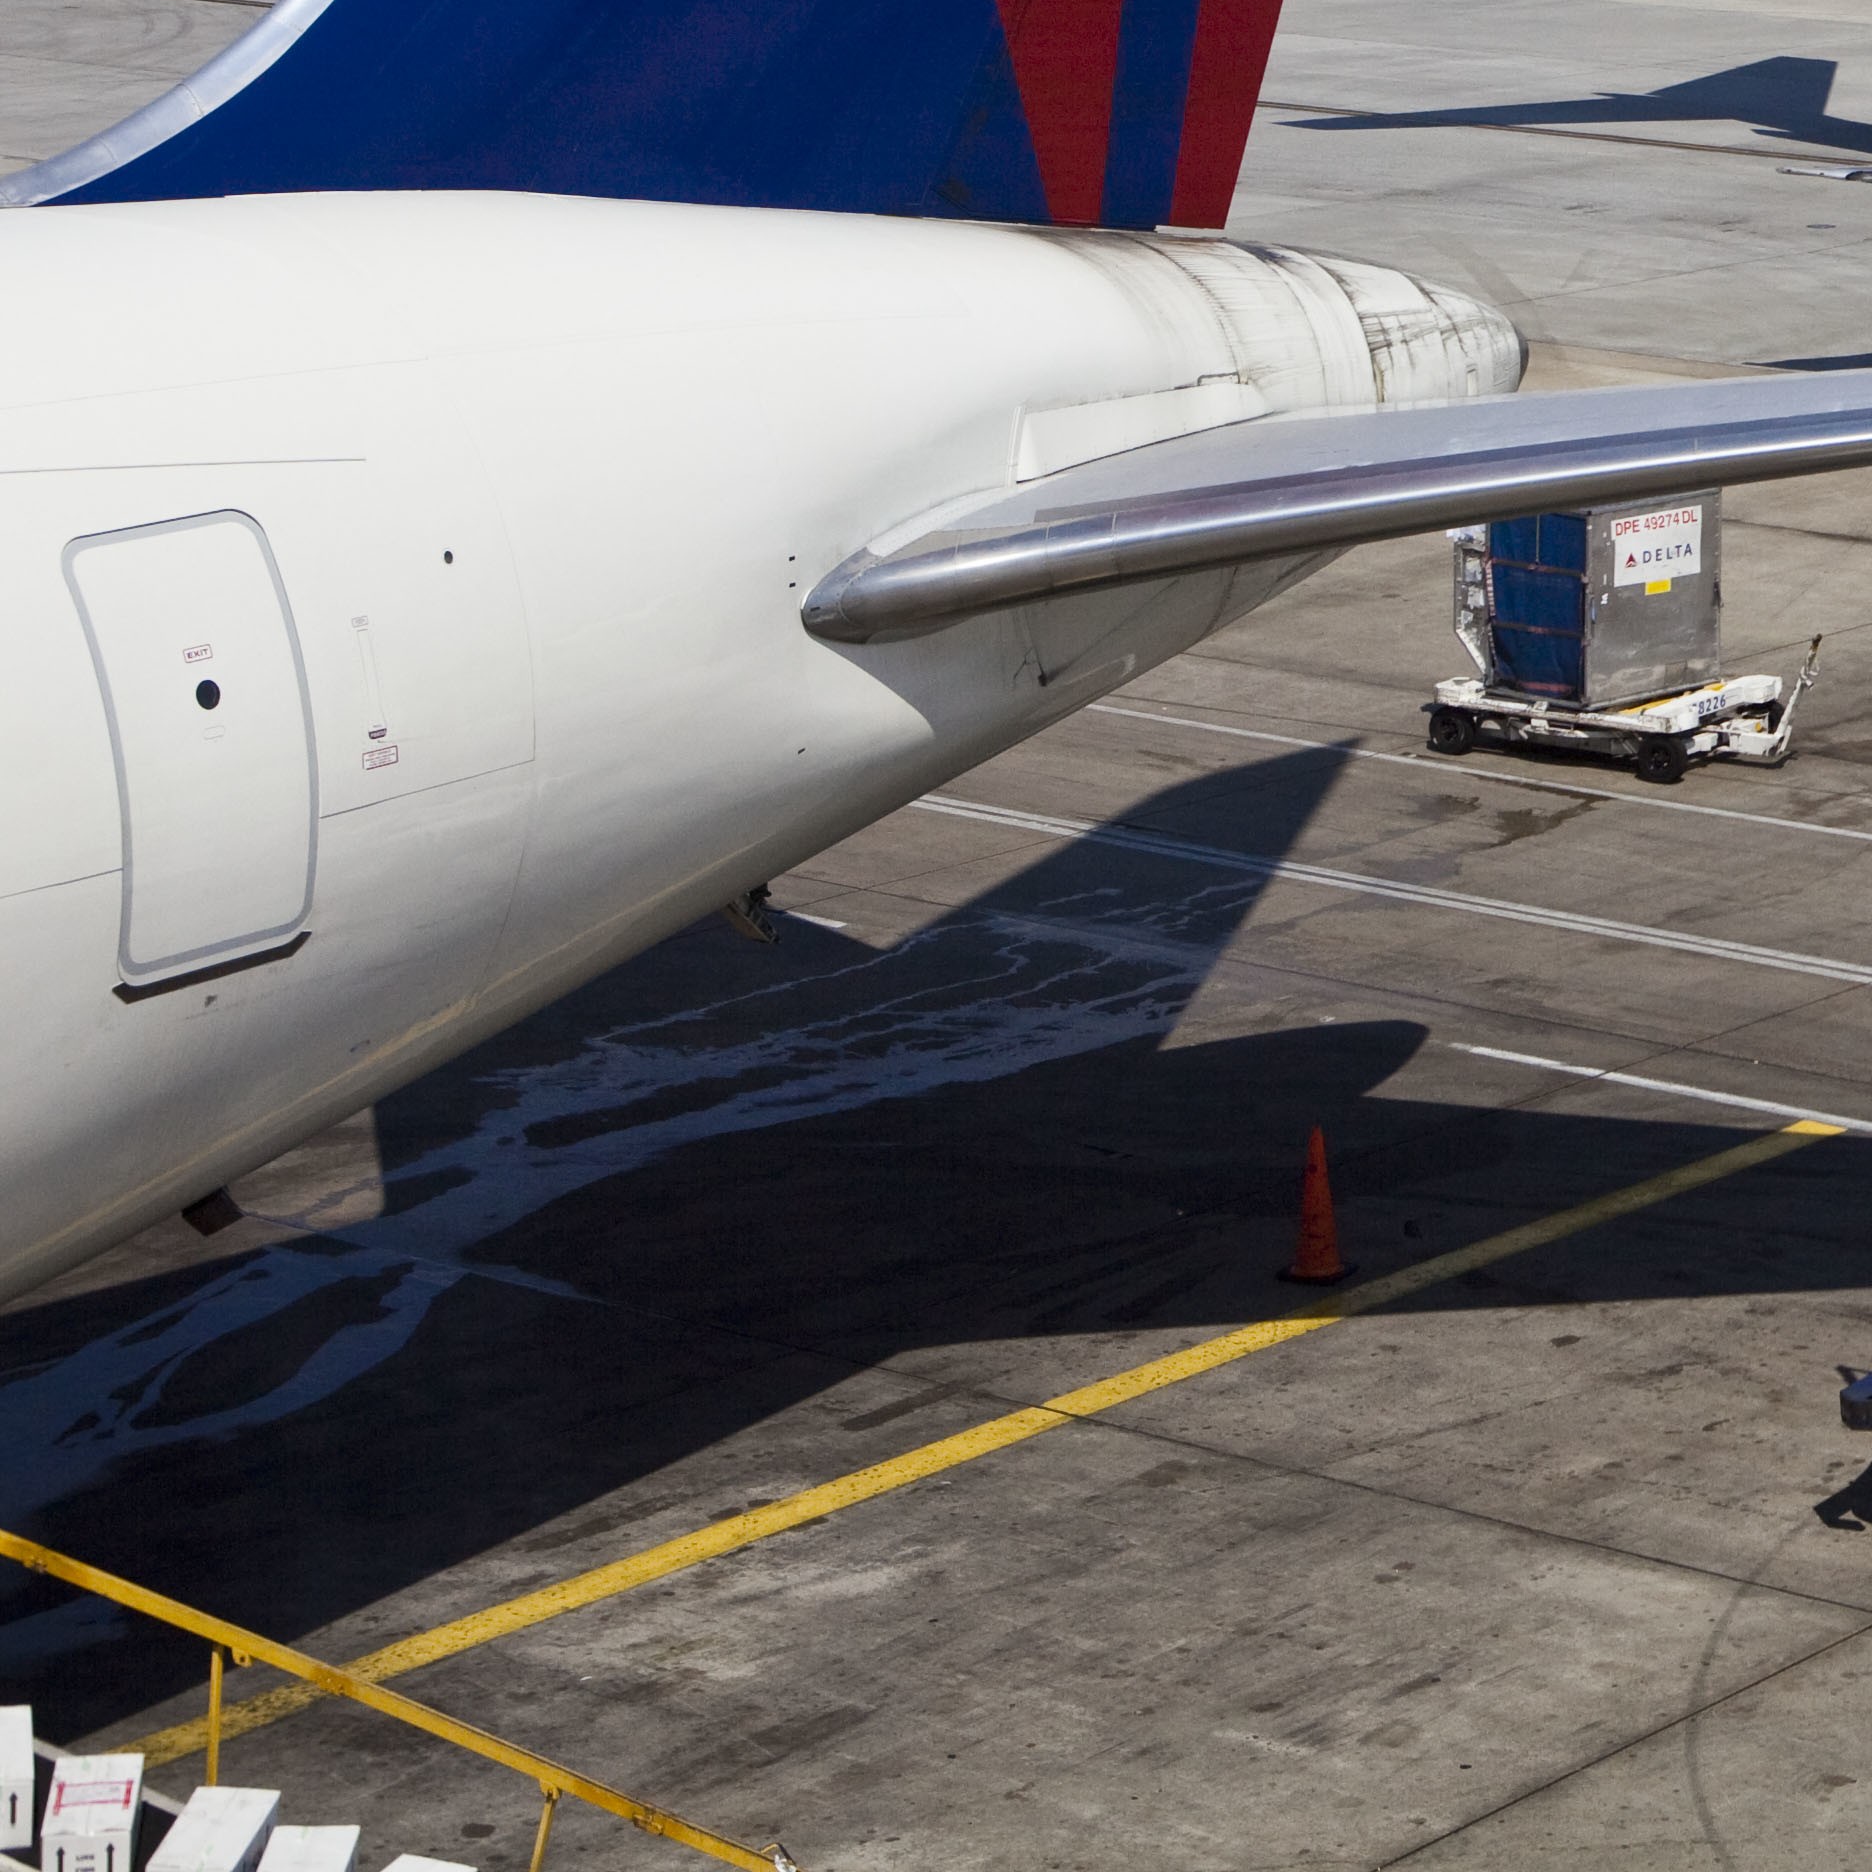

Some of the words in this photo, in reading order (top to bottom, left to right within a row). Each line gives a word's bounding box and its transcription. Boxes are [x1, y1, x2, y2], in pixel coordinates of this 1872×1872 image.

[1615, 520, 1640, 536] DPE
[1644, 513, 1680, 530] 49274
[1682, 510, 1698, 524] DL
[1643, 543, 1692, 564] DELTA
[187, 648, 209, 659] EXIT
[1691, 694, 1726, 715] 8226
